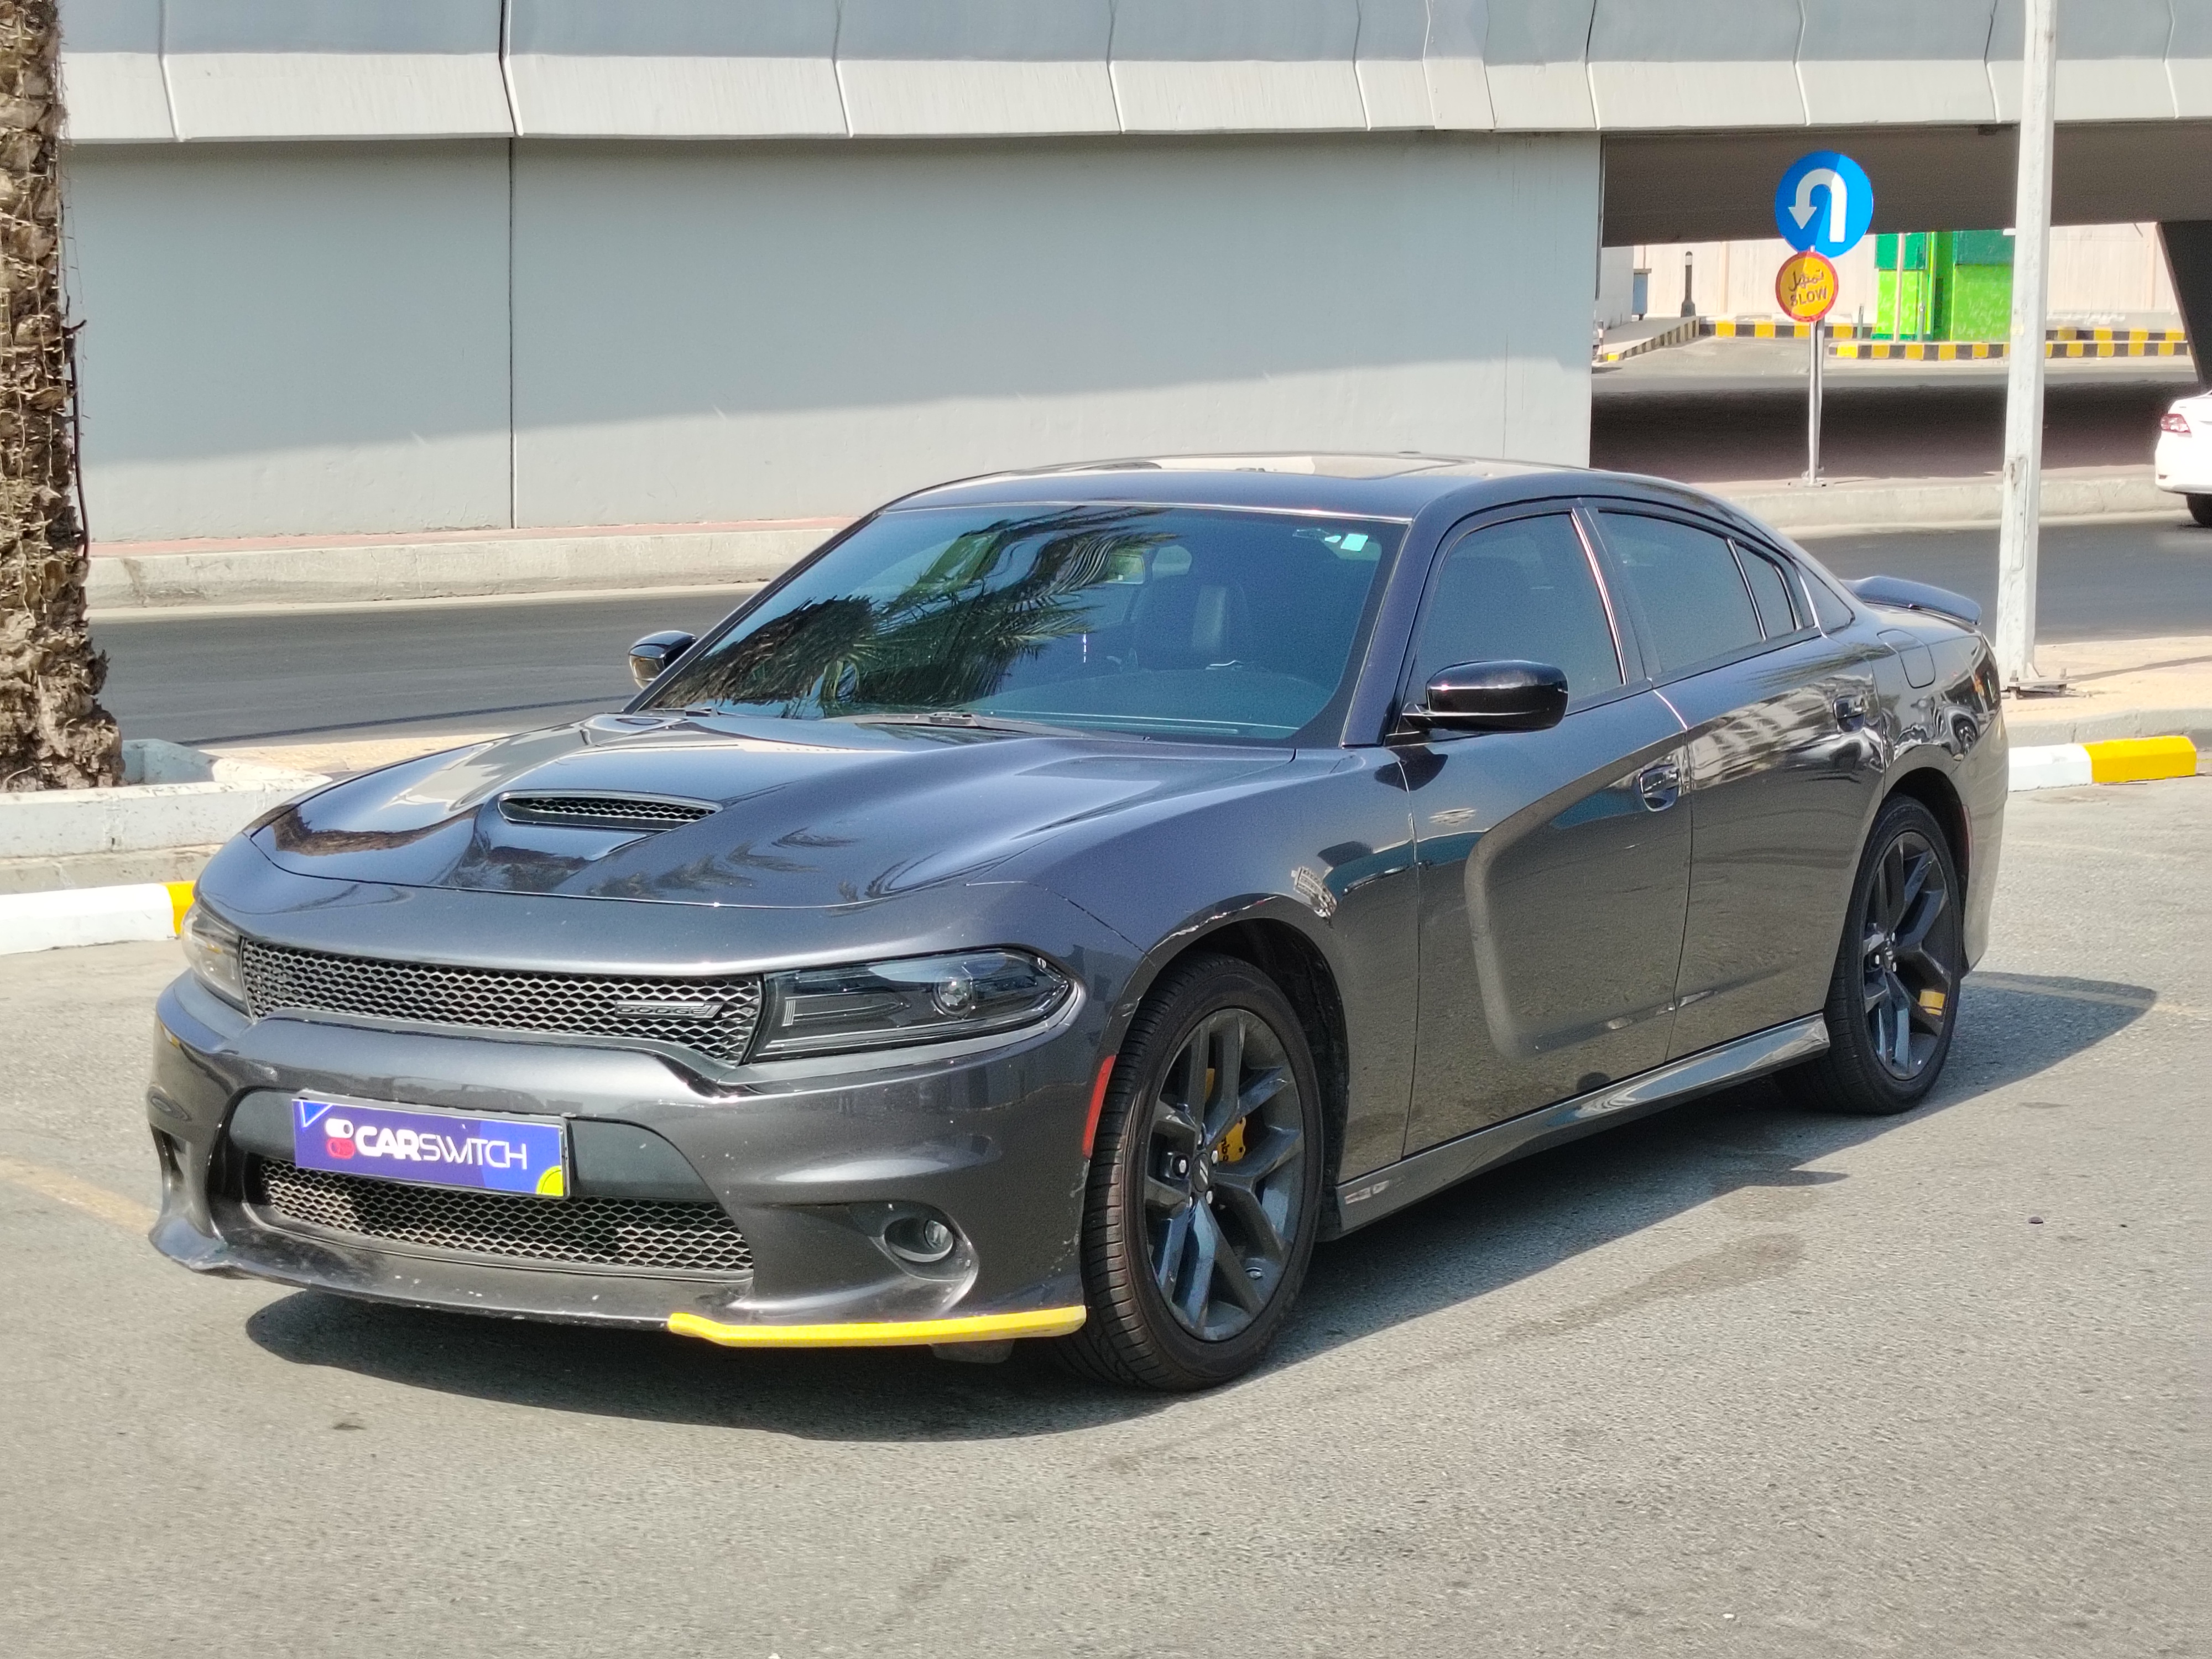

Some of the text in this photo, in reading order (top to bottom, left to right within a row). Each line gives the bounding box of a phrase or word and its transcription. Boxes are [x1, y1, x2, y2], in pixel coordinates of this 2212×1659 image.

[1788, 269, 1824, 291] تمهل
[1790, 286, 1827, 306] SLOW
[354, 1125, 528, 1170] CARSWITCH
